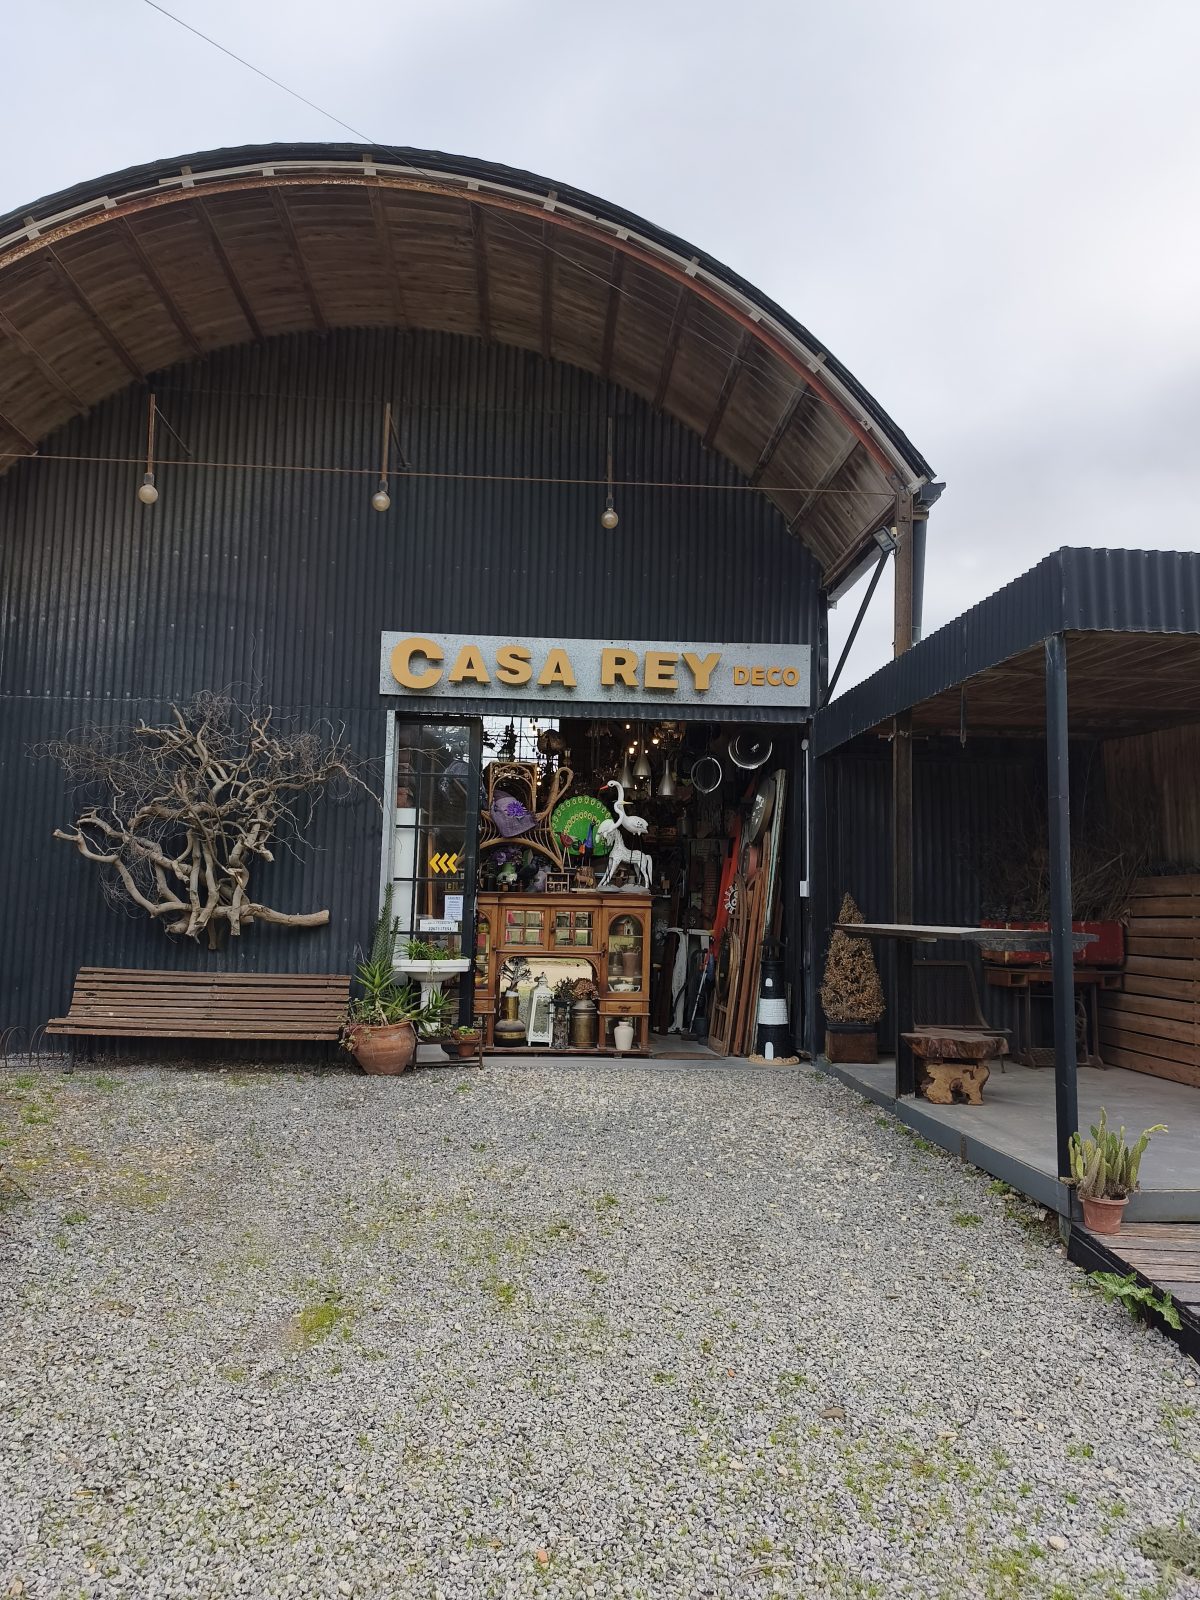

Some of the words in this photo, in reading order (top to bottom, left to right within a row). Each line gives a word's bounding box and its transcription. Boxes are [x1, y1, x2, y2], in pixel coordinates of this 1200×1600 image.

[391, 637, 577, 690] CASA
[601, 648, 721, 691] REY
[733, 666, 800, 687] DECO
